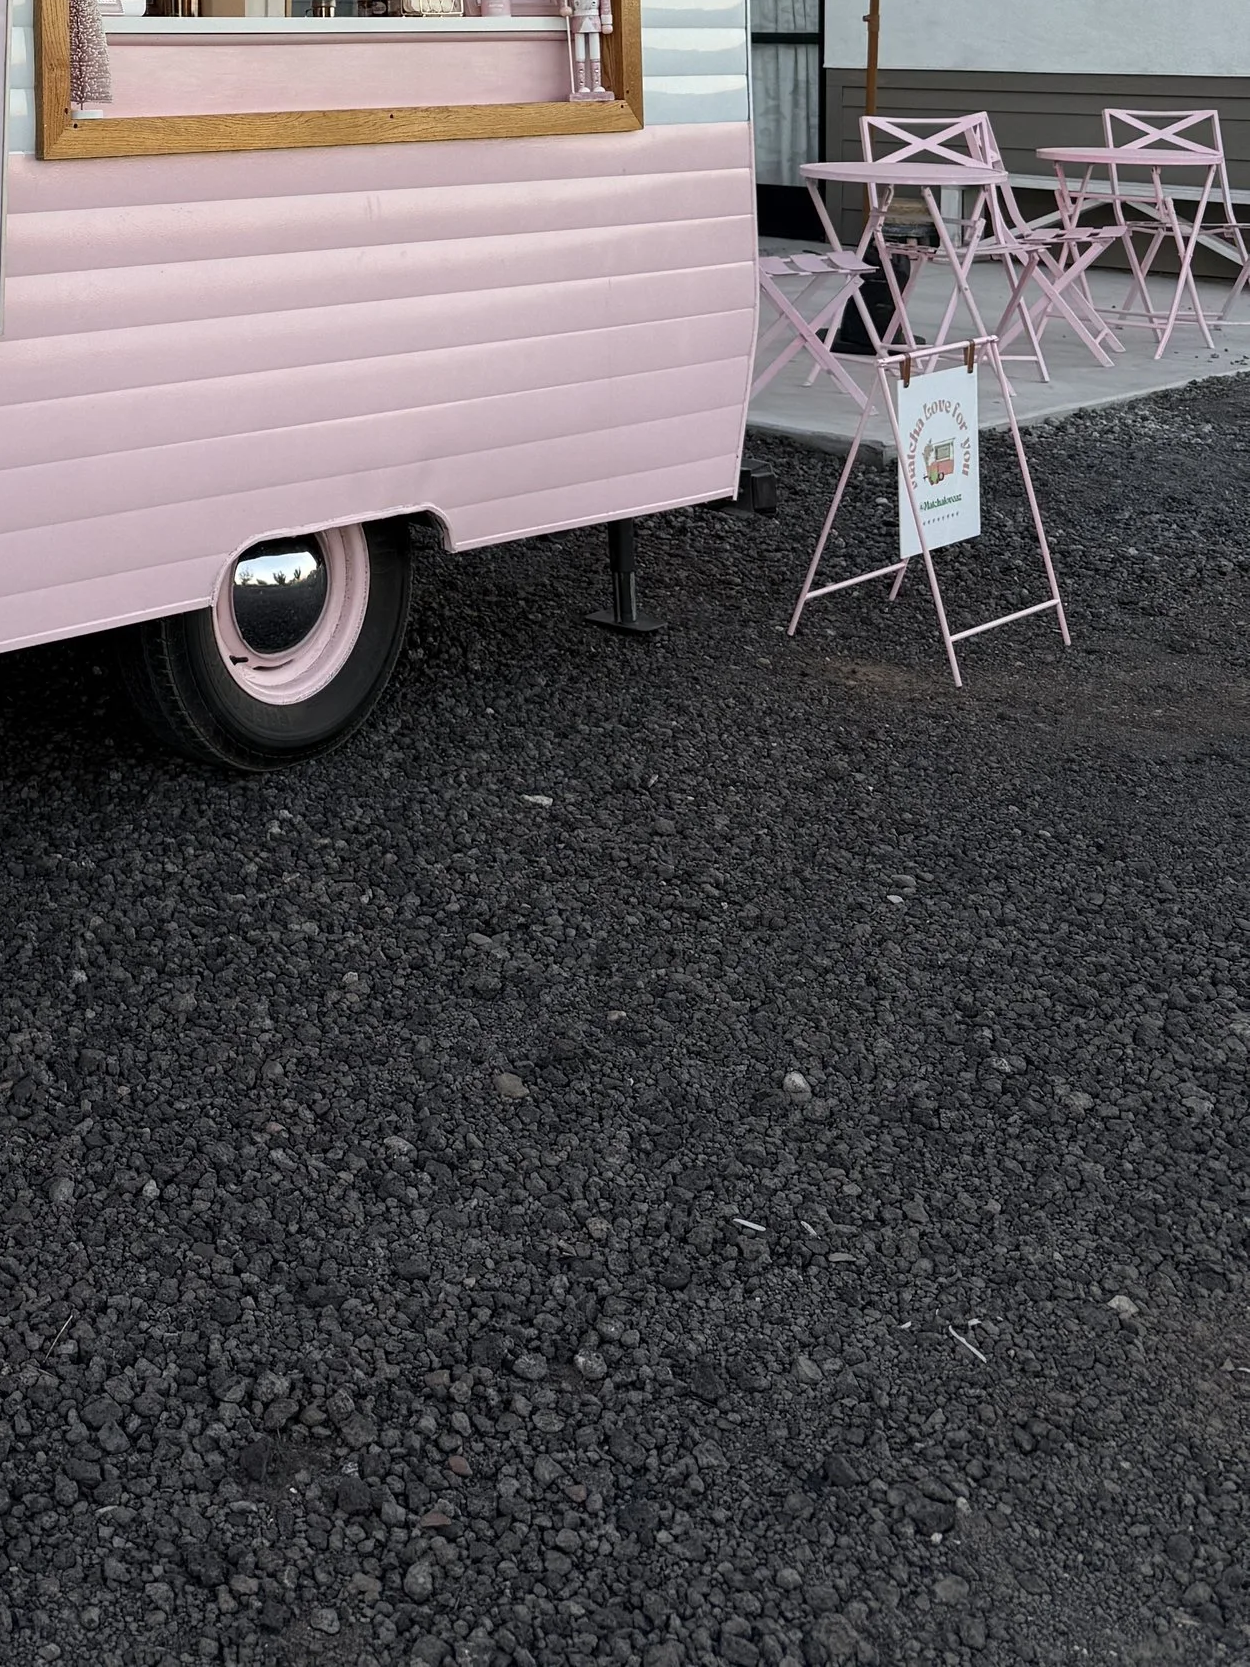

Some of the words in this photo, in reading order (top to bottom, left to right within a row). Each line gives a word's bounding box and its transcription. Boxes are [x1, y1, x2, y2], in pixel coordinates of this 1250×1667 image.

[907, 418, 925, 489] atcha
[952, 402, 968, 431] for
[961, 437, 971, 477] you
